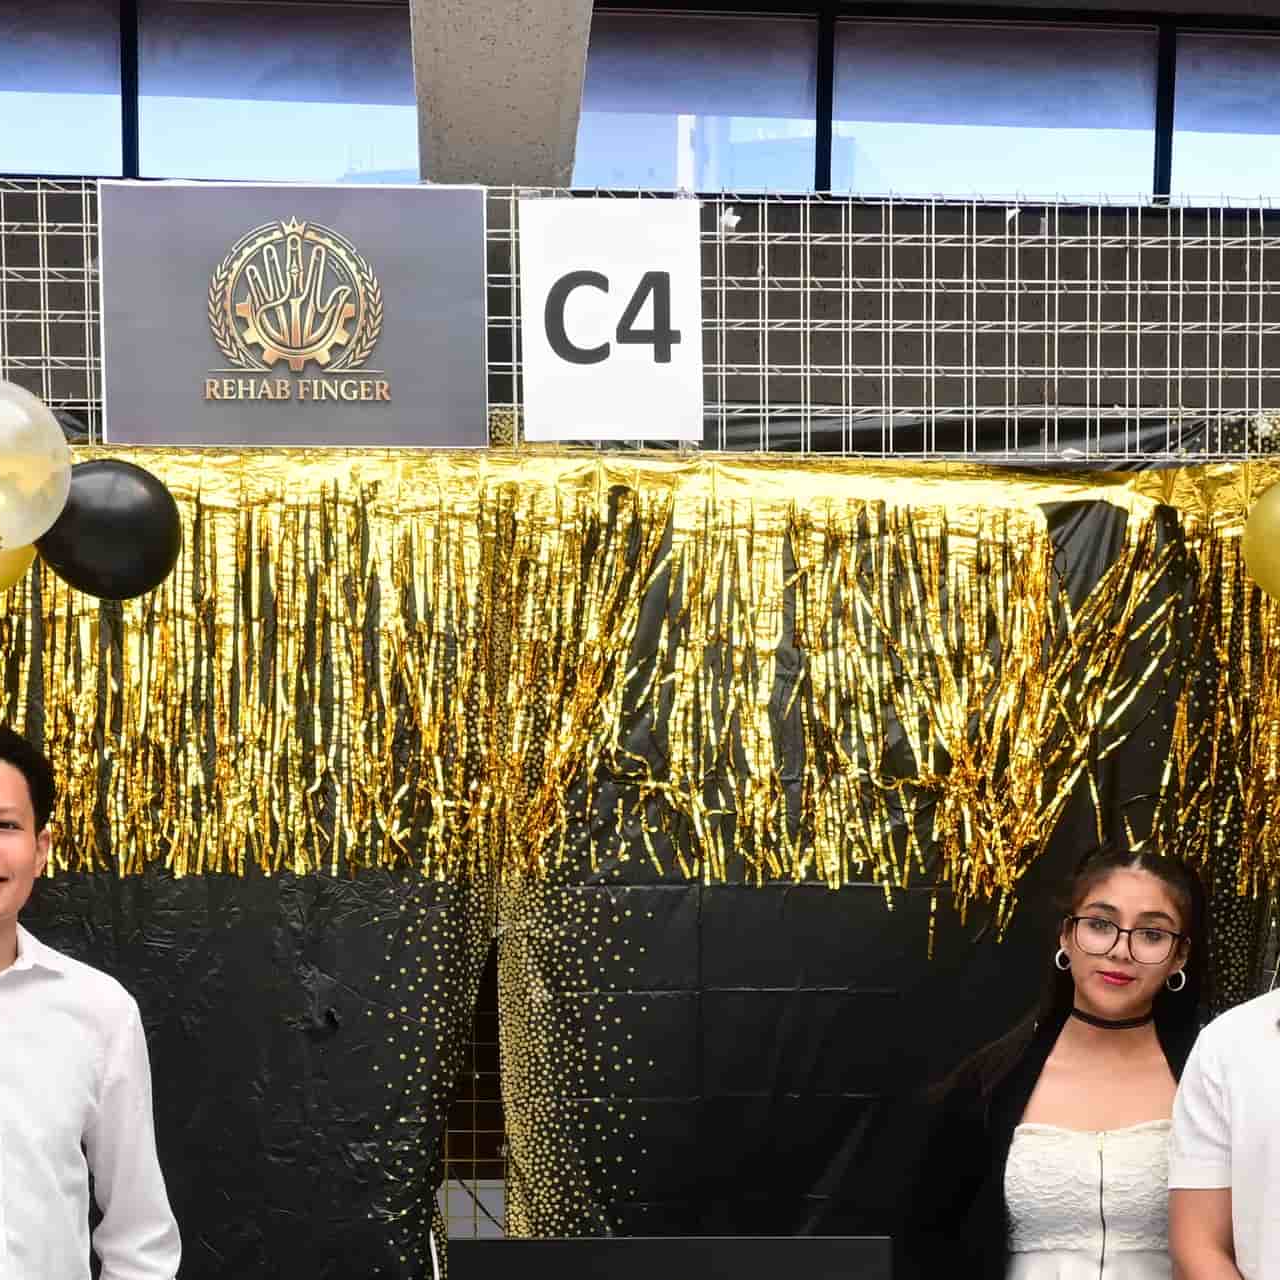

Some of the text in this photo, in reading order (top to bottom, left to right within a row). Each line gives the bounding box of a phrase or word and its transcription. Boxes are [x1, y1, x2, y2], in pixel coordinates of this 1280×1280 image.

[543, 269, 682, 365] C4
[204, 377, 392, 402] REHAB FINGER
